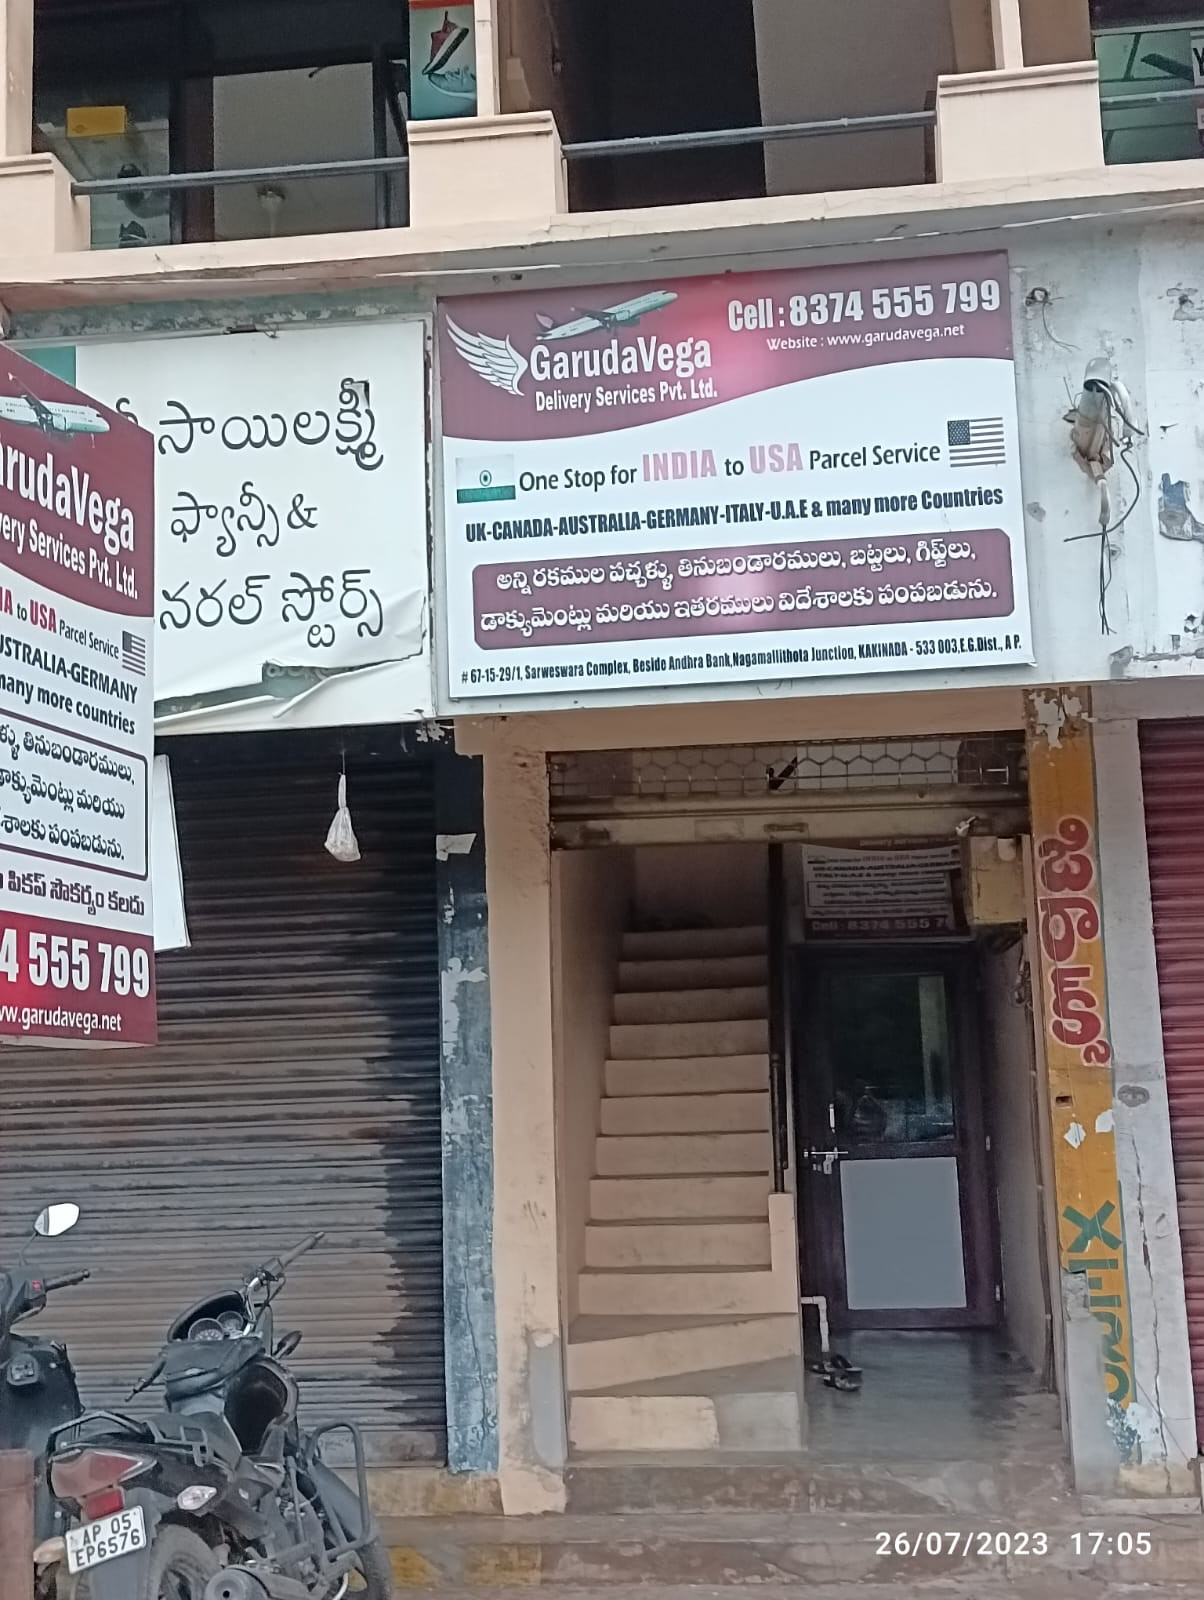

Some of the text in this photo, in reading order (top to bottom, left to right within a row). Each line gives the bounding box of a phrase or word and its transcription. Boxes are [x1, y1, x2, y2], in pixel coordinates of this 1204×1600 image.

[728, 298, 774, 332] Cell
[789, 291, 864, 327] 8374
[872, 285, 934, 319] 555
[941, 280, 1000, 314] 799
[530, 335, 712, 381] GarudaVega
[766, 335, 818, 351] Website
[827, 324, 965, 347] www.garudavega.net
[536, 377, 718, 413] Delivery Services Pvt. Ltd.
[158, 377, 384, 471] సాయిలక్ష్మీ
[519, 439, 941, 492] One Stop for INDIA to USA Parcel Service
[286, 493, 318, 529] &
[811, 501, 823, 517] &
[826, 496, 871, 517] many
[874, 492, 918, 513] more
[921, 487, 1003, 509] Countries
[0, 512, 138, 600] ery Services Pvt. Ltd.
[497, 571, 532, 595] అన్ని
[533, 565, 605, 587] రకముల
[678, 550, 846, 577] తినుబండారములు,
[850, 544, 912, 572] బట్టలు,
[17, 603, 28, 621] to
[30, 599, 57, 634] USA
[59, 619, 86, 646] Parcel
[89, 632, 120, 660] Service
[480, 579, 997, 637] డాక్యుమెంట్లు మరియు ఇతరములు విదేశాలకు పంపబడును.
[525, 663, 585, 679] Sarweswara
[586, 660, 631, 677] Complex,
[633, 656, 667, 673] Beside
[669, 655, 704, 670] Andhra
[811, 645, 857, 662] Junction,
[859, 641, 908, 659] KAKINADA
[916, 639, 935, 655] 533
[37, 685, 73, 713] more
[76, 700, 135, 735] countries
[76, 789, 125, 819] మరియు
[48, 823, 124, 861] పంపబడును.
[108, 890, 145, 916] కలదు
[29, 931, 90, 992] 555
[98, 943, 150, 998] 799
[76, 1529, 141, 1567] EP6576
[83, 1513, 132, 1546] AP 05
